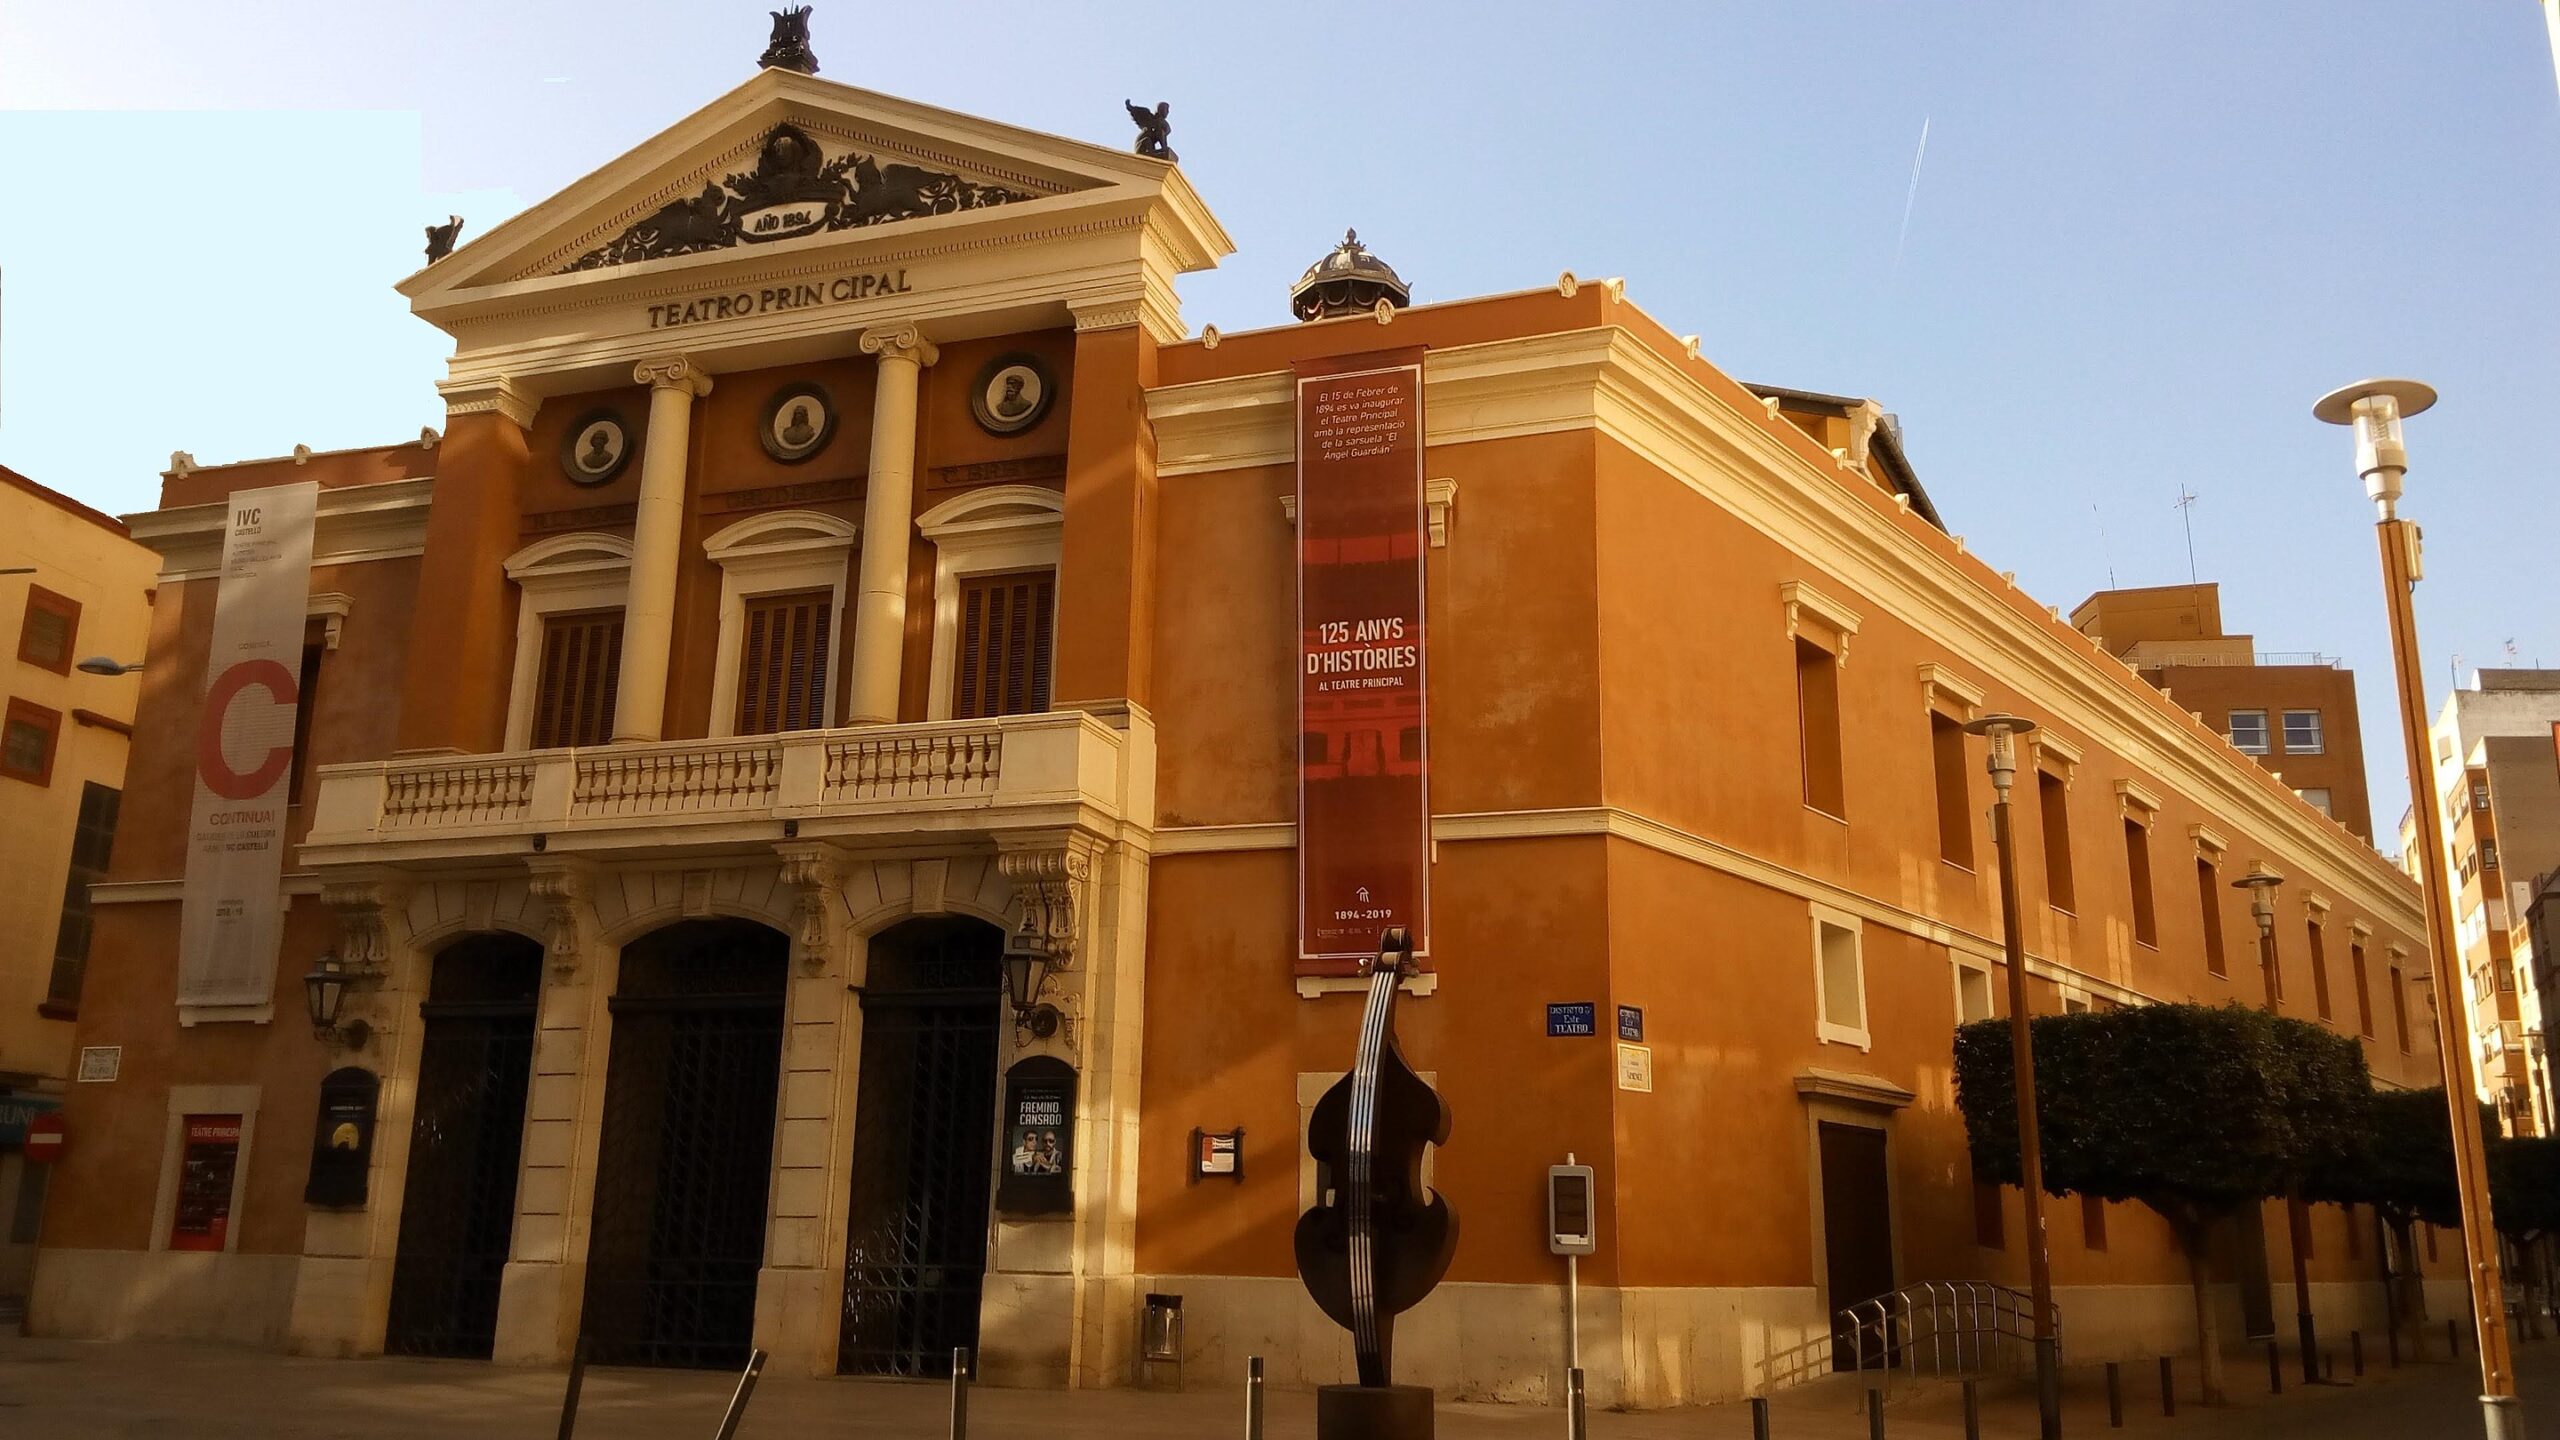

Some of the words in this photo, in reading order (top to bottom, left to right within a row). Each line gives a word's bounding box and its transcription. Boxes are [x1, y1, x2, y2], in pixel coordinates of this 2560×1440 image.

[754, 213, 780, 233] AÑO
[782, 210, 812, 228] 1894
[648, 294, 752, 328] TEATRO
[1320, 393, 1329, 402] El
[1332, 391, 1341, 401] 15
[1343, 390, 1354, 399] de
[1356, 387, 1386, 398] Febrer
[1387, 385, 1399, 394] de
[1315, 405, 1334, 415] 1894
[1337, 404, 1347, 412] es
[1349, 402, 1360, 410] va
[1362, 397, 1405, 409] inaugurar
[1321, 416, 1329, 426] el
[1332, 414, 1358, 424] Teatre
[1360, 408, 1398, 420] Principal
[1313, 428, 1333, 438] amb
[1335, 427, 1344, 435] la
[1346, 419, 1406, 434] representació
[1321, 440, 1333, 449] de
[1335, 438, 1343, 447] la
[1345, 435, 1383, 446] sarsuela
[236, 508, 261, 526] IVC
[1319, 621, 1350, 645] 125
[1355, 617, 1404, 642] ANYS
[1307, 643, 1416, 675] D'HISTÒRIES
[1319, 681, 1329, 692] AL
[1331, 679, 1360, 690] TEATRE
[1362, 676, 1404, 688] PRINCIPAL
[1550, 1006, 1584, 1014] DISTRITO
[1555, 1024, 1588, 1033] TEATRO
[1019, 1114, 1062, 1126] CANSADO
